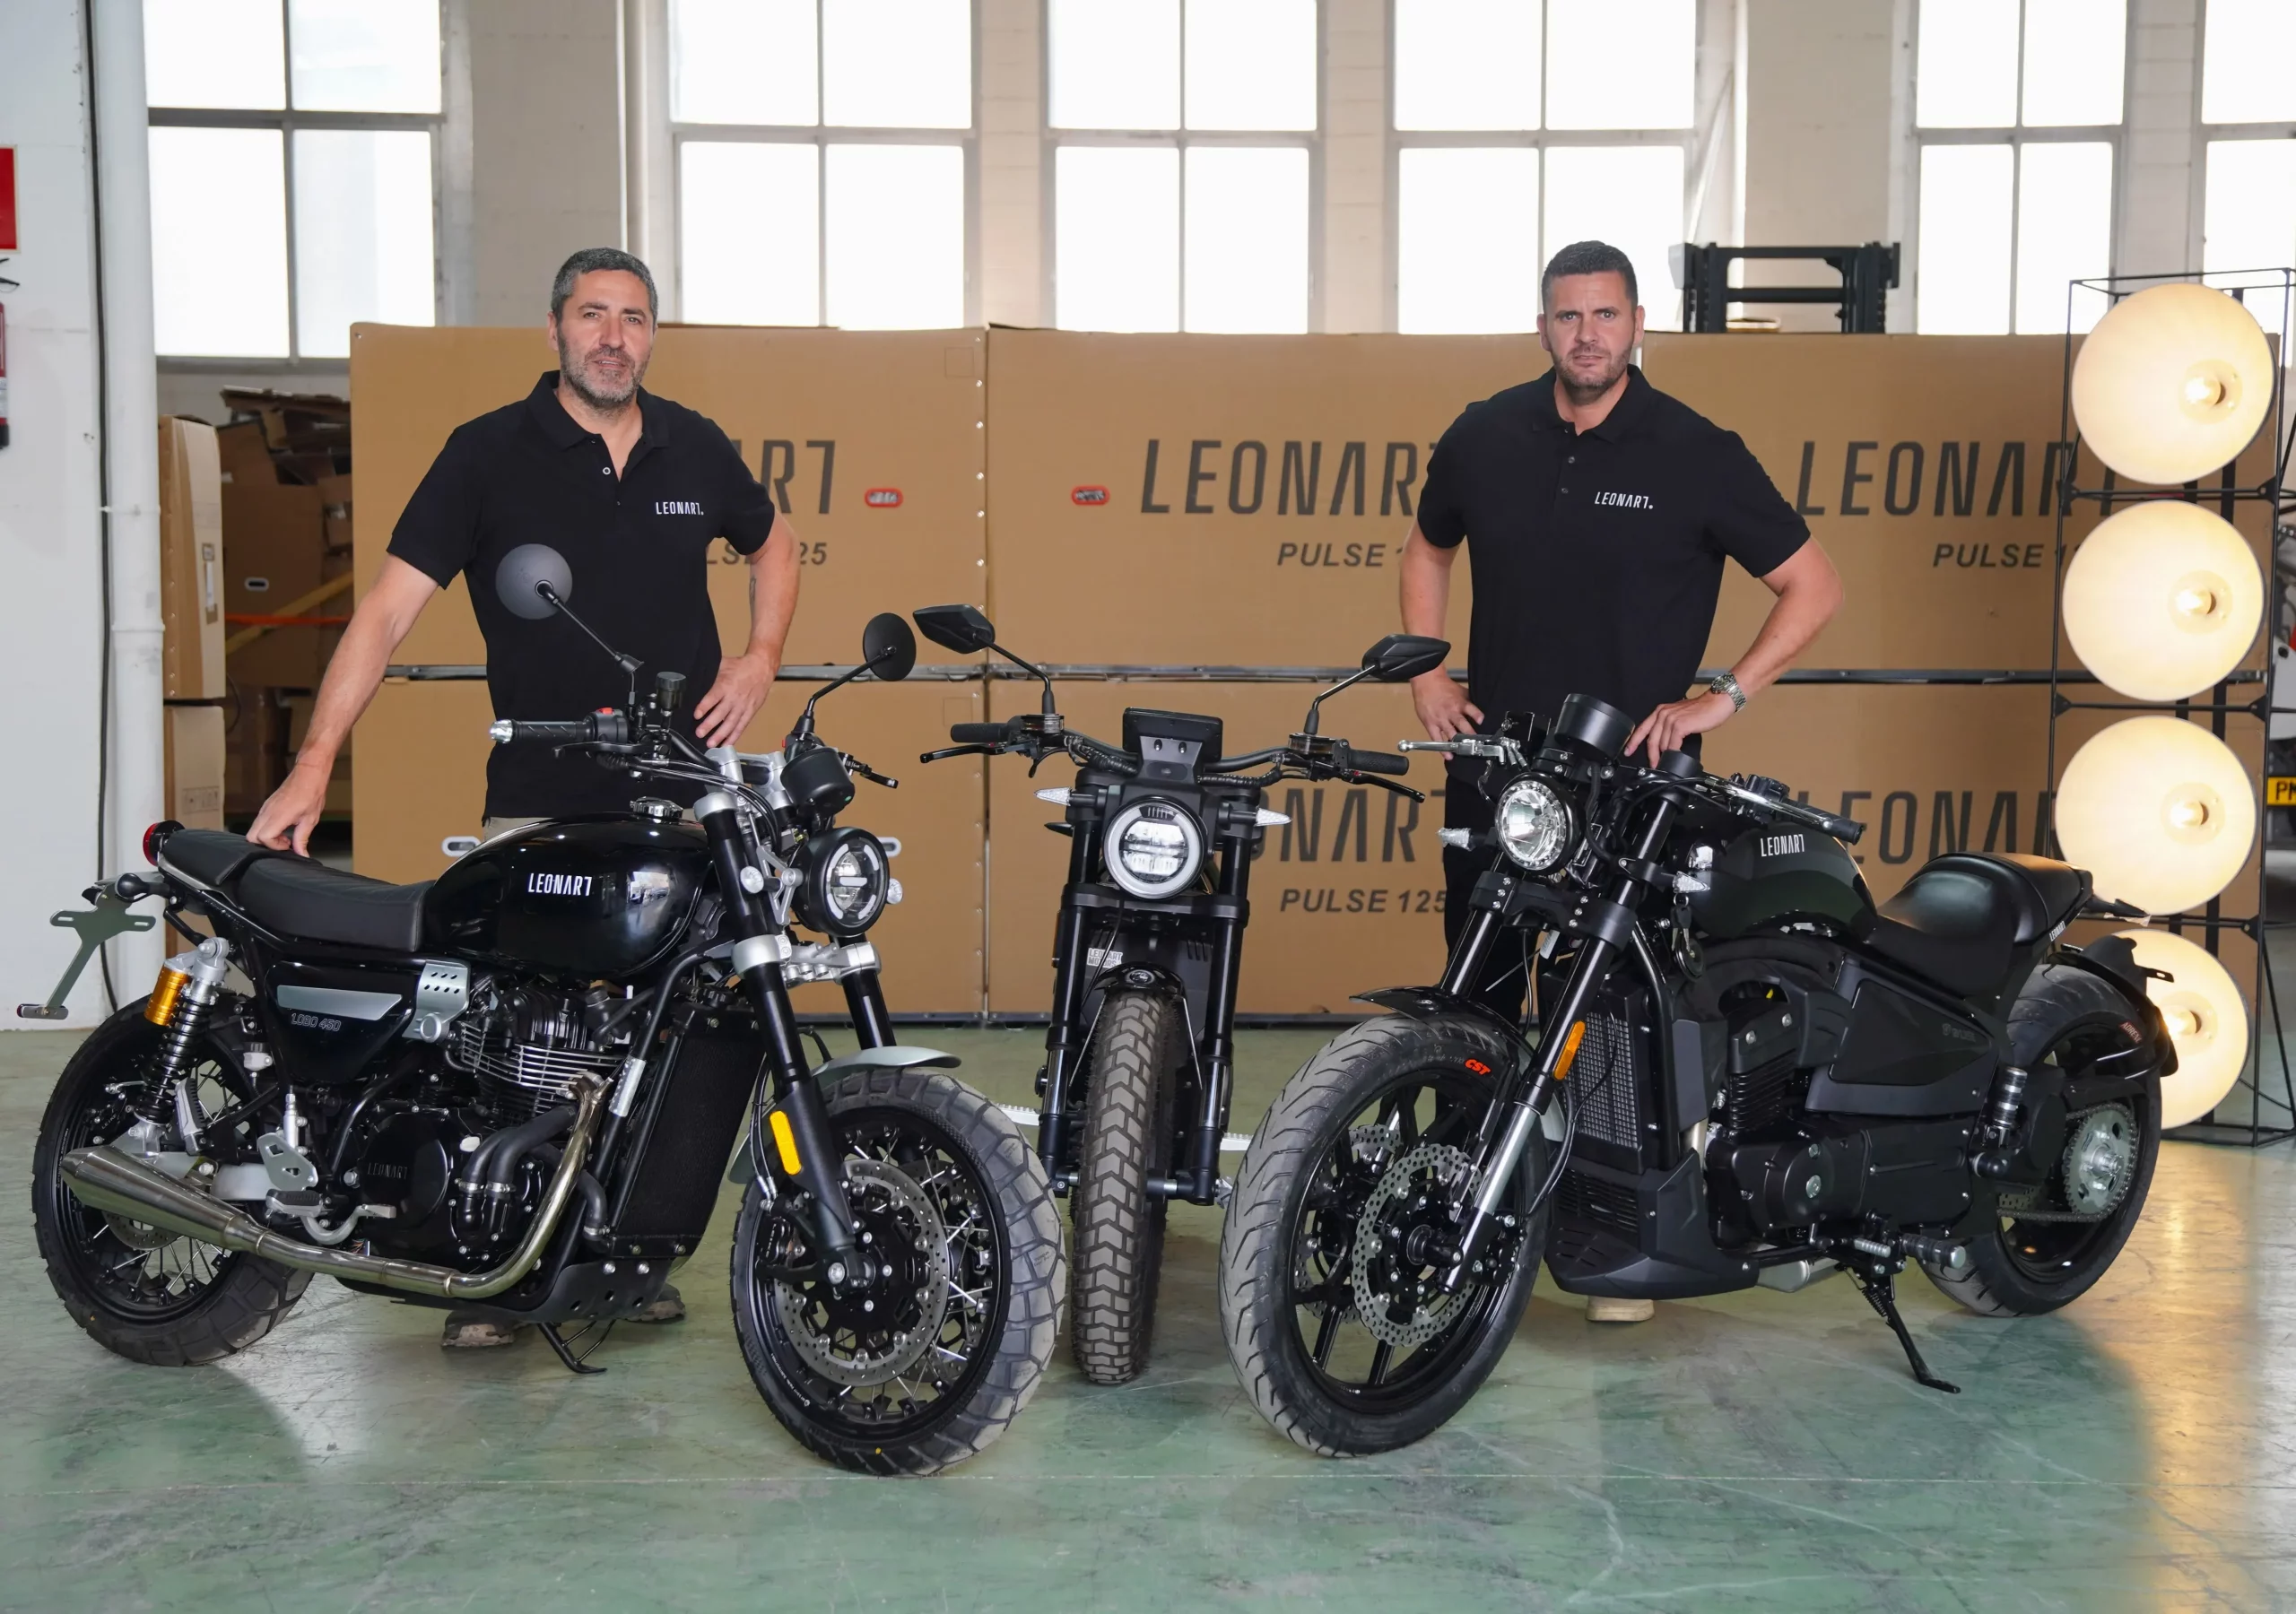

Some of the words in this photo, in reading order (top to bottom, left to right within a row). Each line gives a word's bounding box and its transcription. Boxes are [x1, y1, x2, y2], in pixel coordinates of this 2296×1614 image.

[1141, 439, 1439, 516] LEONAR
[1277, 542, 1387, 567] PULSE
[1933, 543, 2044, 568] PULSE
[1761, 834, 1805, 857] LEONART
[528, 872, 592, 896] LEONART
[1280, 889, 1388, 913] PULSE
[1089, 949, 1122, 961] LEOART
[318, 1018, 342, 1032] 450
[1465, 1059, 1492, 1075] CST
